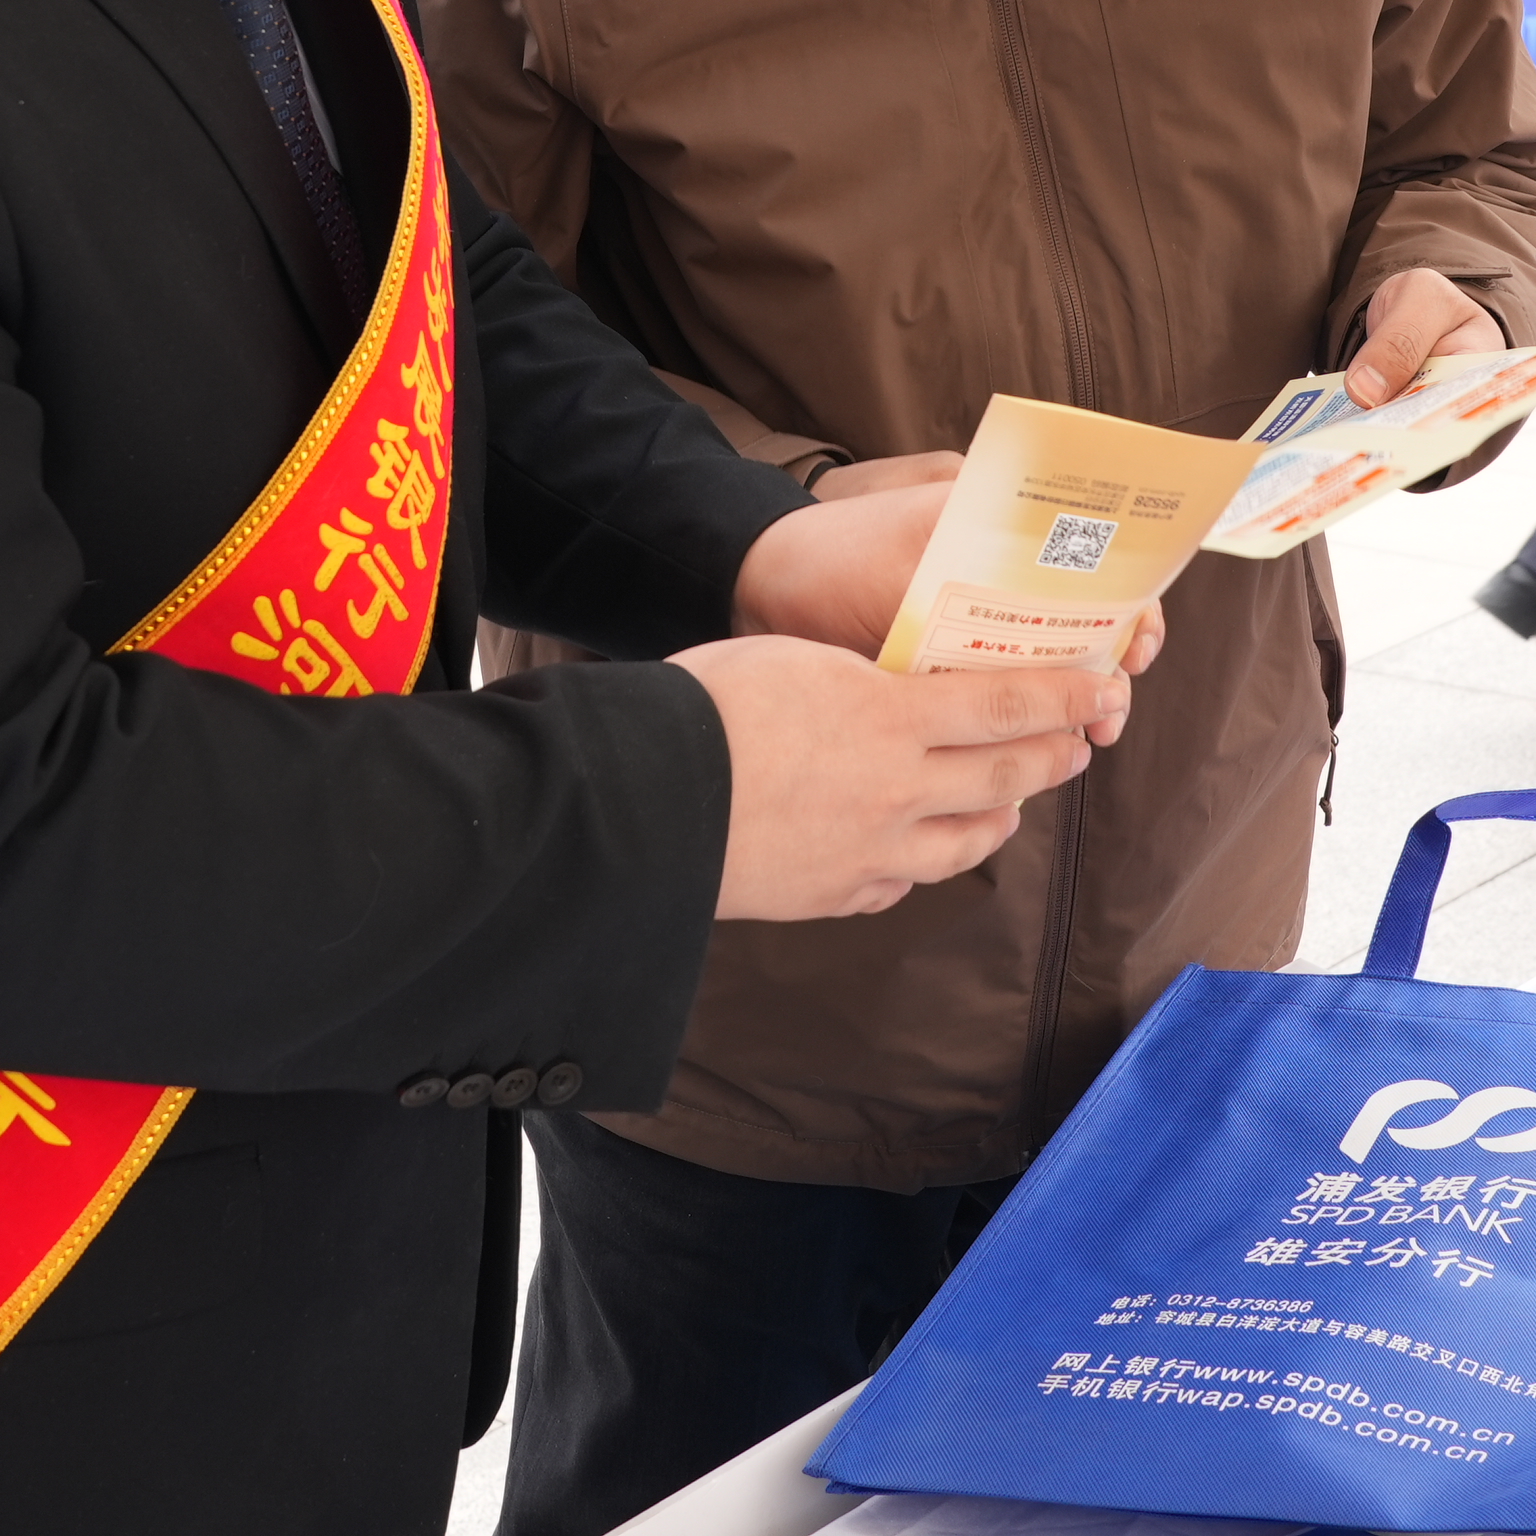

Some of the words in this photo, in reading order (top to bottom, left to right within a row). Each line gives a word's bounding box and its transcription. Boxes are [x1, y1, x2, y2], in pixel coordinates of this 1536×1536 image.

[1133, 495, 1182, 511] 95528
[1281, 1204, 1376, 1226] SPD
[1378, 1204, 1524, 1245] BANK
[1243, 1237, 1495, 1288] 雄安分行
[1036, 1373, 1490, 1465] 手机银行wap.spdb.com.cn
[1051, 1351, 1517, 1447] 网上银行www.spdb.com.cn
